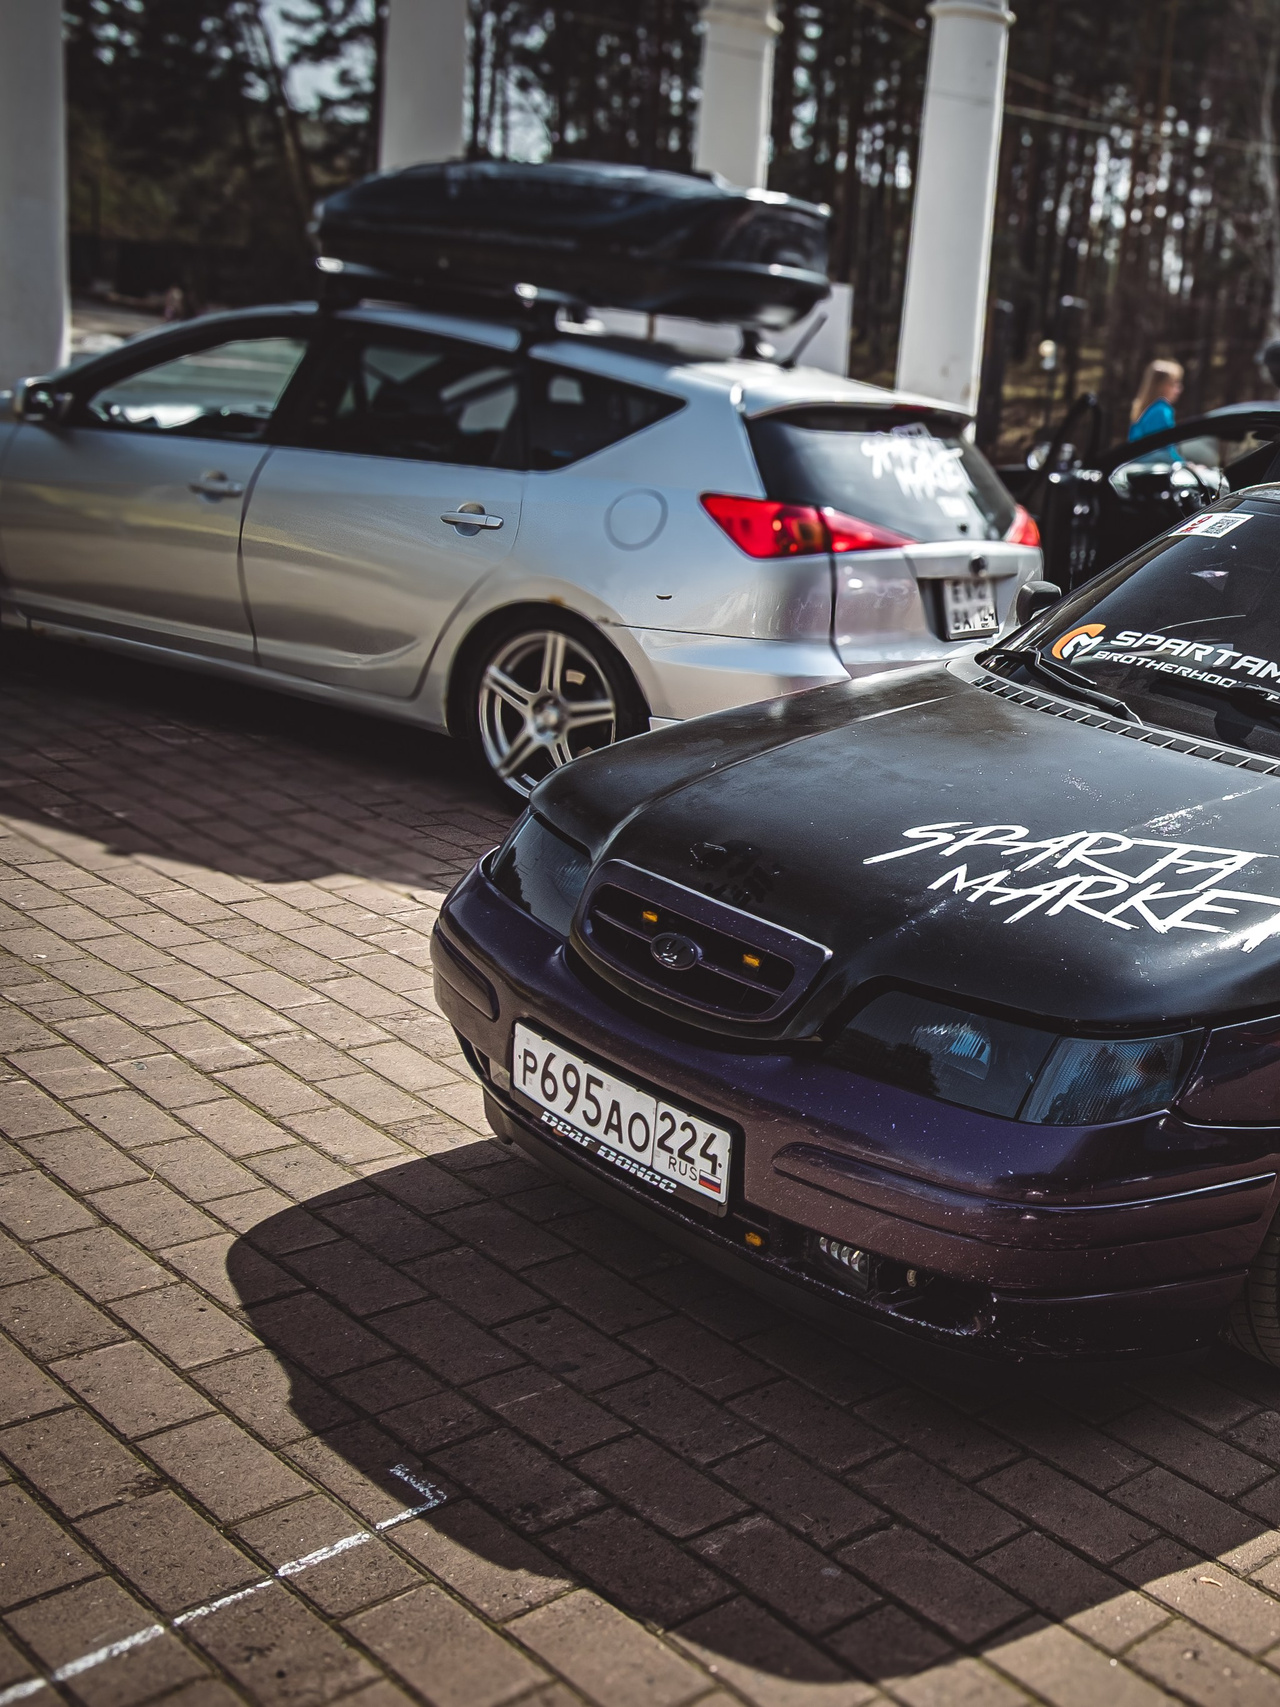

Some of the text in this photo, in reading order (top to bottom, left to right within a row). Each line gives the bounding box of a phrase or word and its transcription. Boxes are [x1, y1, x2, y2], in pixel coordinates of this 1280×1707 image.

[1092, 650, 1243, 689] BROTHERHOO
[862, 821, 1280, 884] SPARTA
[656, 1111, 719, 1176] 224
[668, 1156, 698, 1182] RUS
